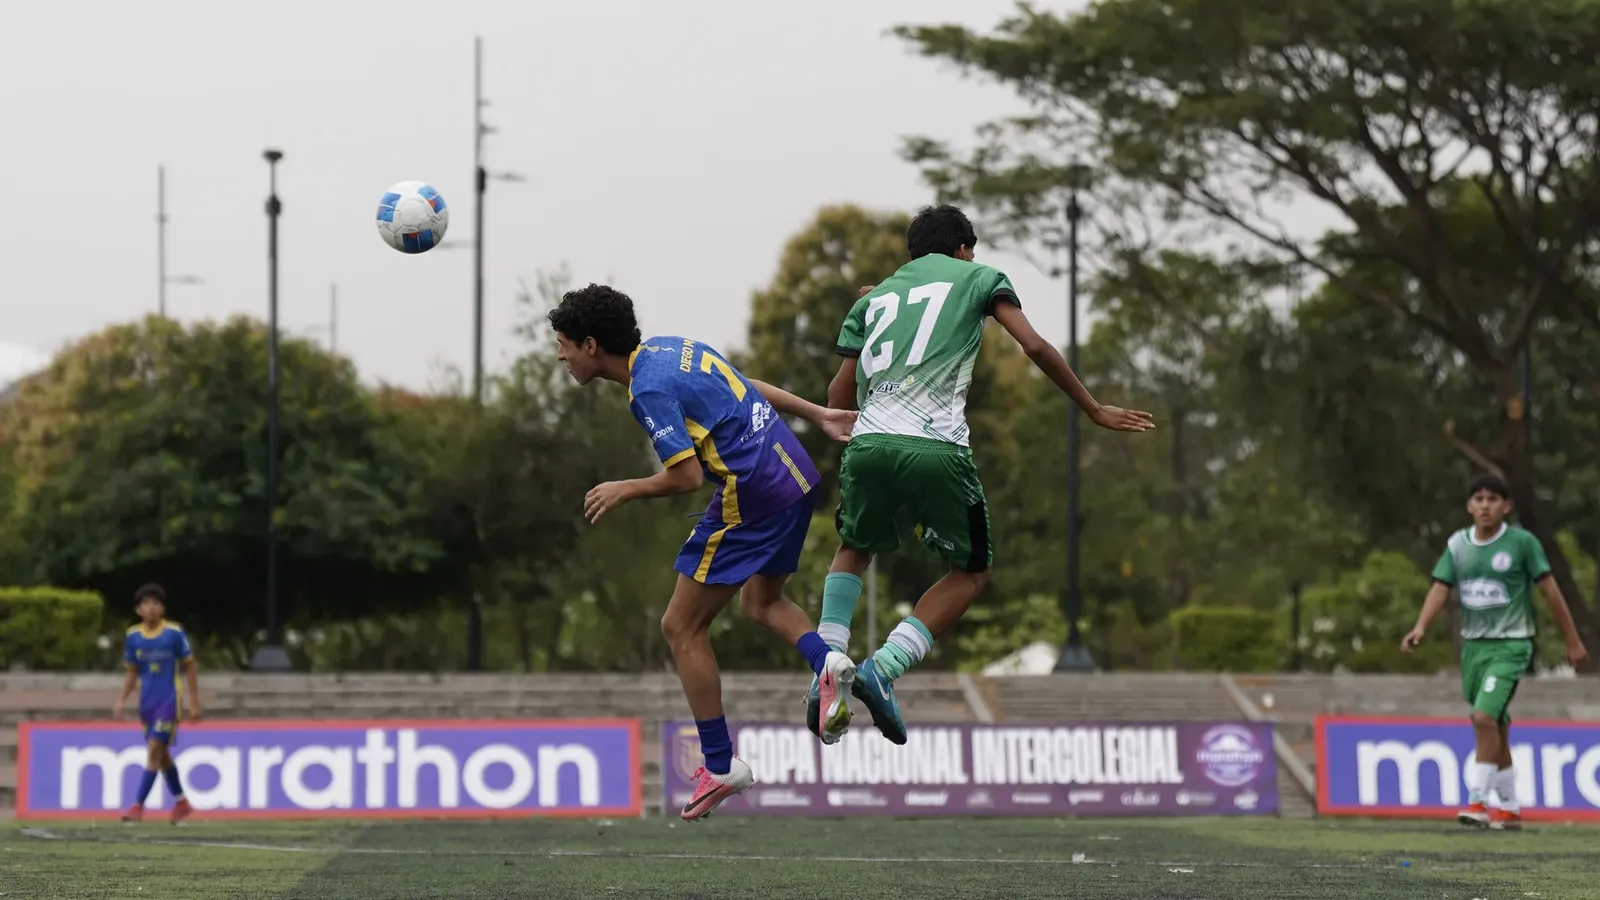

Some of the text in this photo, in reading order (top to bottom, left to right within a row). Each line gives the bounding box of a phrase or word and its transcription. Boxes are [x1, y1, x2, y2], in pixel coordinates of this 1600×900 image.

[680, 346, 694, 373] DIEGO
[860, 281, 954, 380] 27
[700, 350, 748, 403] 7
[60, 728, 602, 810] marathon
[737, 726, 1185, 785] COPA NACIONAL INTERCOLEGIAL
